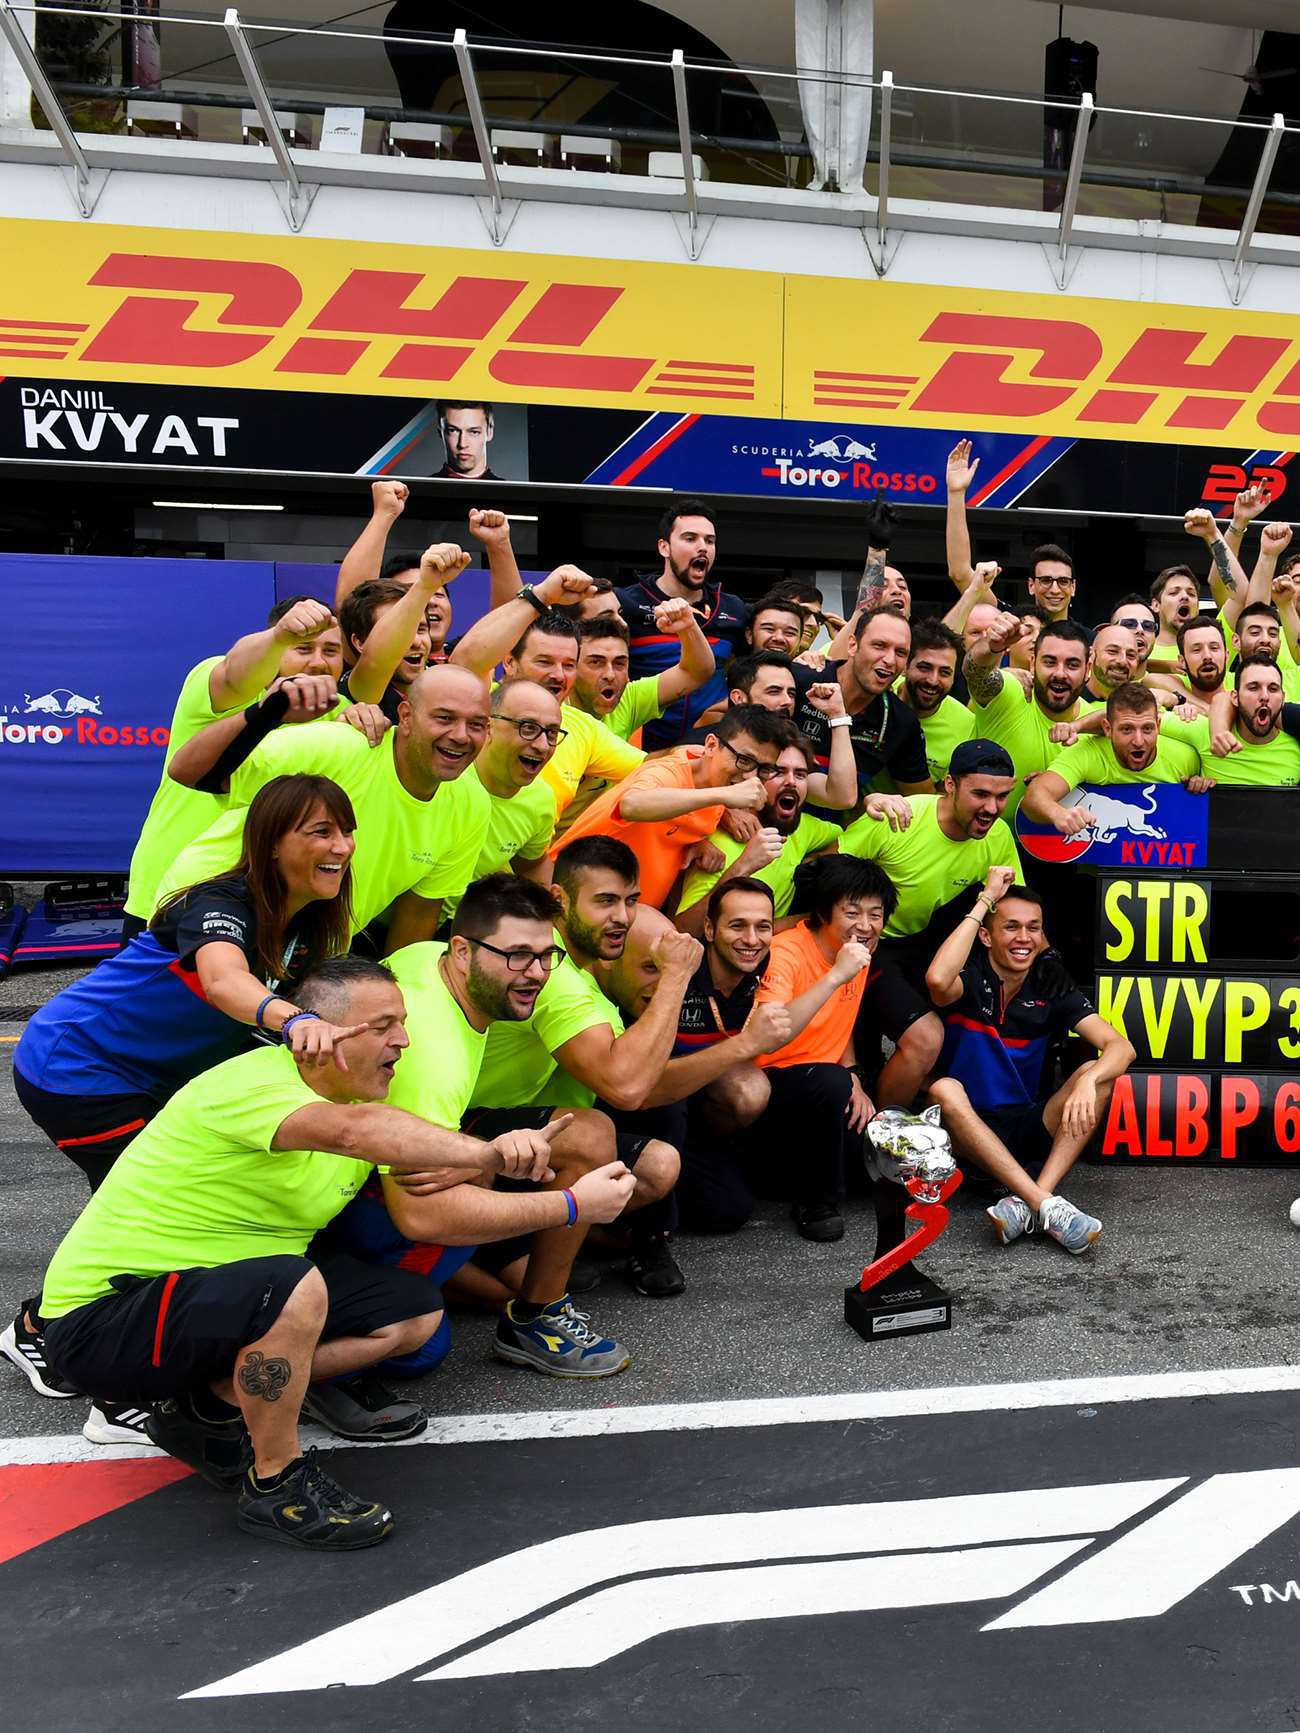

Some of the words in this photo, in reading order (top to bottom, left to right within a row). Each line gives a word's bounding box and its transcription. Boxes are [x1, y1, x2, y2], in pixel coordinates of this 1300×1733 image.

[78, 253, 656, 392] DHL
[21, 387, 114, 410] DANIIL
[23, 408, 239, 456] KVYAT
[732, 444, 804, 458] SCUDERIA
[775, 458, 841, 487] Toro
[852, 462, 937, 493] Rosso
[77, 717, 170, 746] Rosso
[1121, 841, 1196, 865] KVYAT
[1104, 880, 1208, 963] STR
